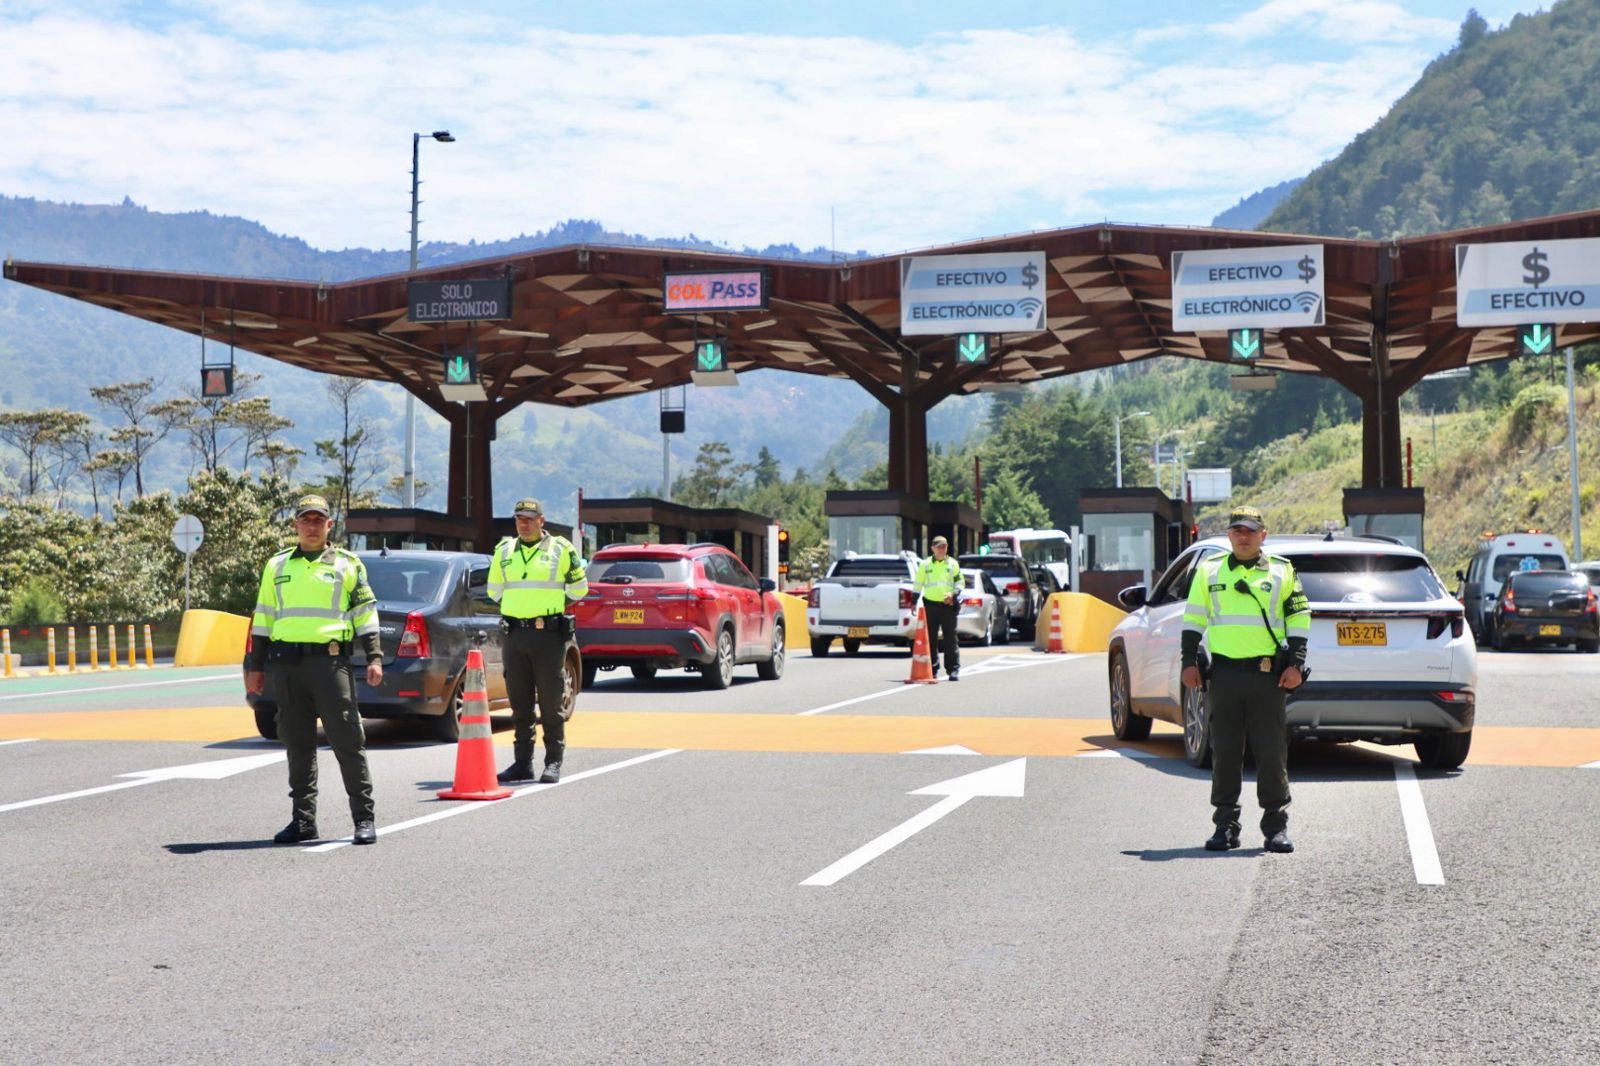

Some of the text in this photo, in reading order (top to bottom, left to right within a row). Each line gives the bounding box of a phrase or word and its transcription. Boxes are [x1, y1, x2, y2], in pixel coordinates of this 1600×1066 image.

[936, 262, 1039, 289] EFECTIVO $
[1208, 255, 1317, 284] EFECTIVO $
[1522, 247, 1551, 289] $
[441, 284, 473, 300] SOLO
[667, 280, 758, 302] COL PASS
[1490, 290, 1586, 310] EFECTIVO
[415, 300, 498, 319] ELECTRONICO
[912, 301, 1016, 319] ELECTRÓNICO
[1184, 296, 1292, 316] ELECTRÓNICO
